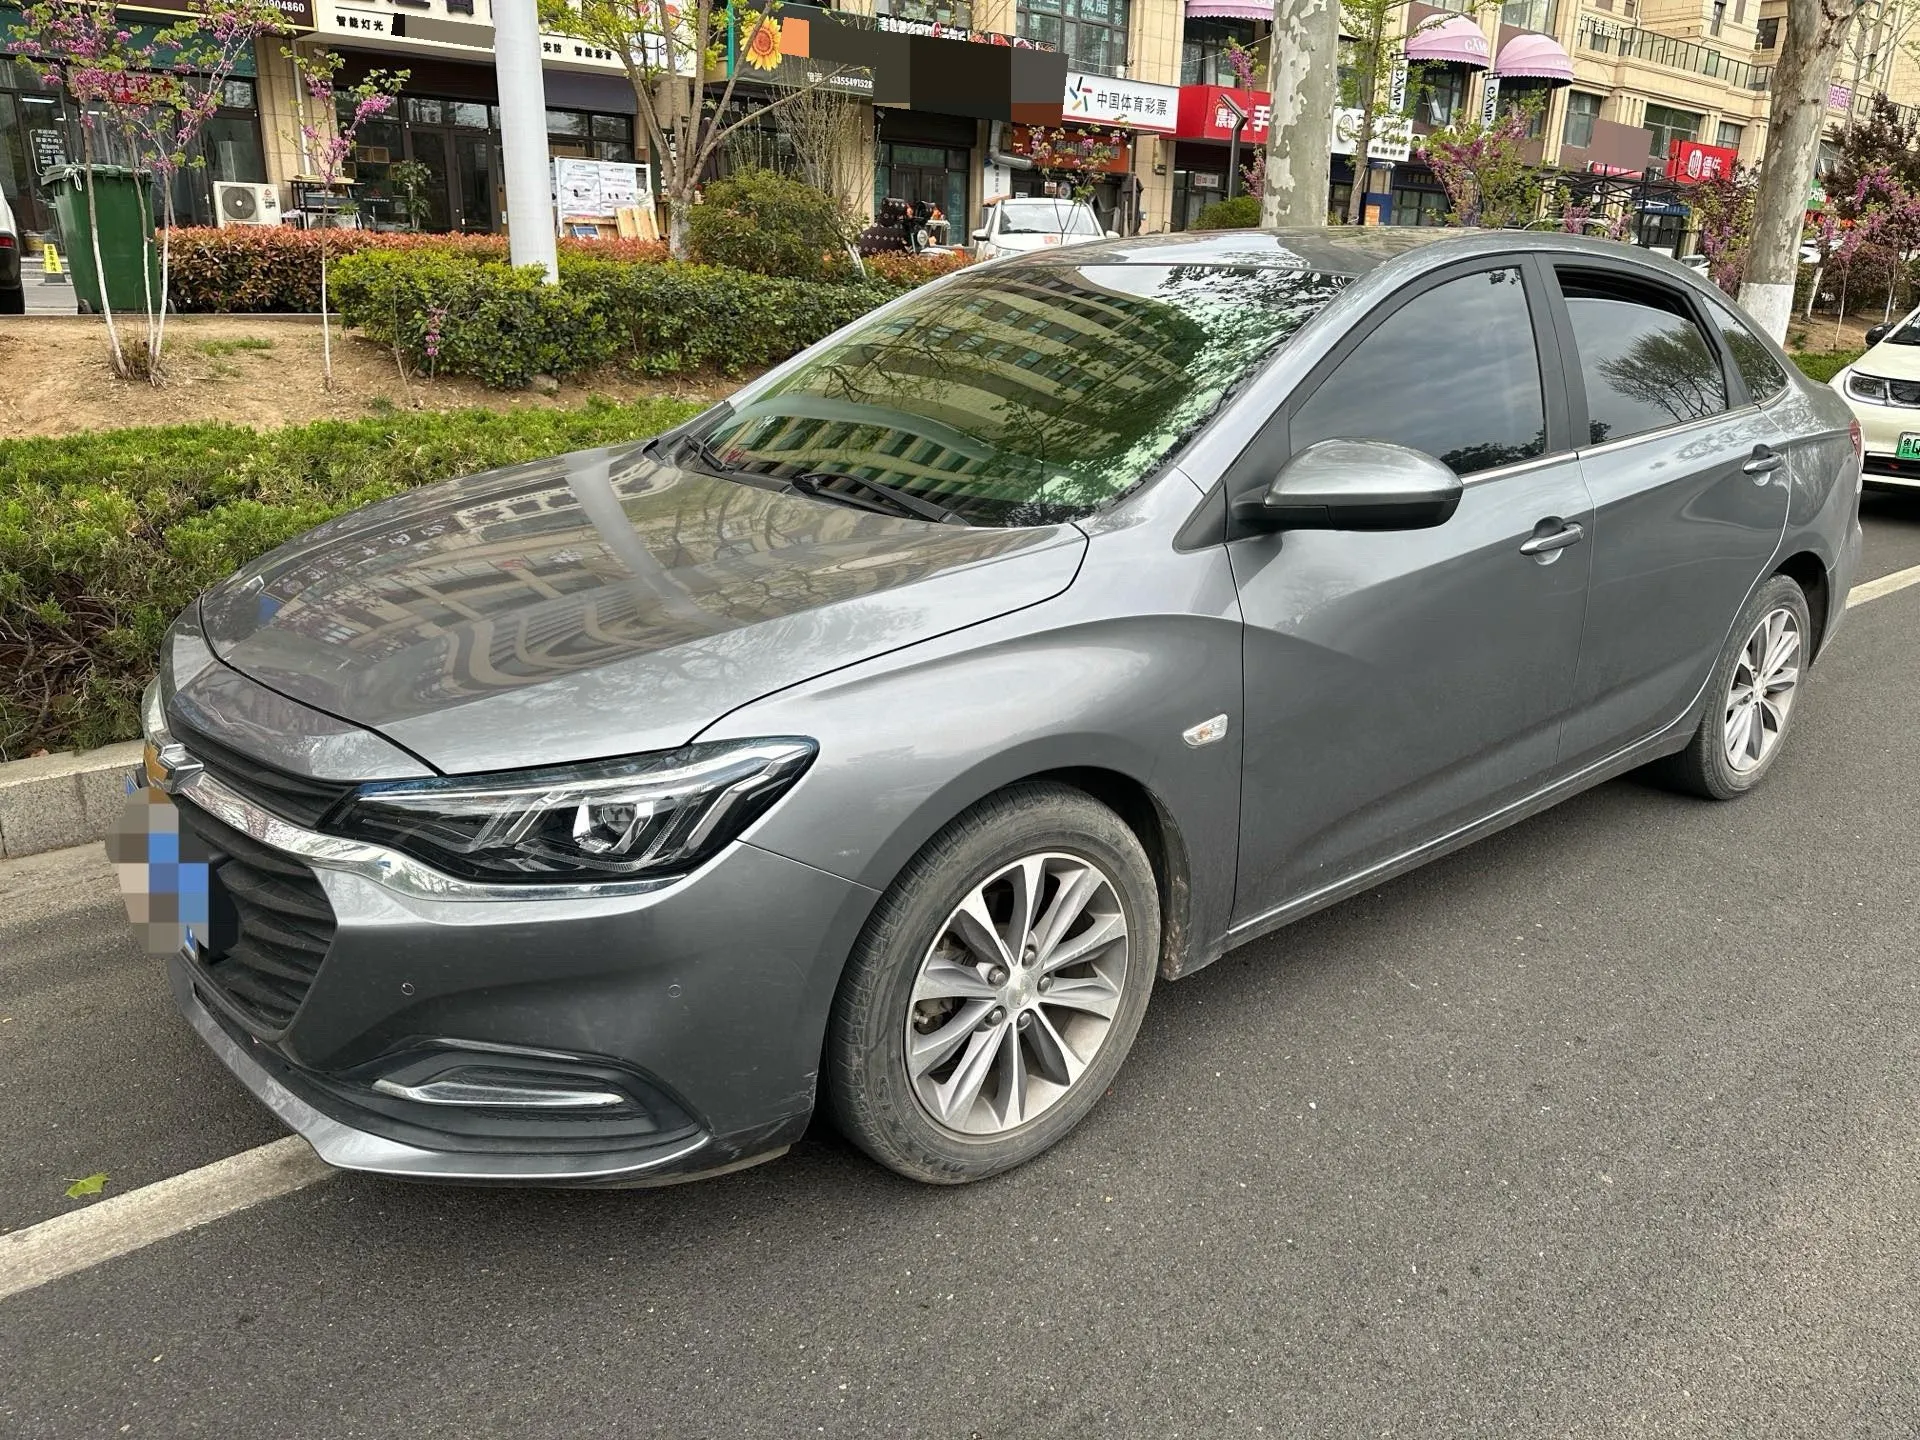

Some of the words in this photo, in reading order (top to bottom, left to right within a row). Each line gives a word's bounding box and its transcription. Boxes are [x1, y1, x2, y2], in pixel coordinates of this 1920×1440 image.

[336, 15, 384, 31] 智能灯光
[1097, 90, 1168, 116] 中国体育彩票
